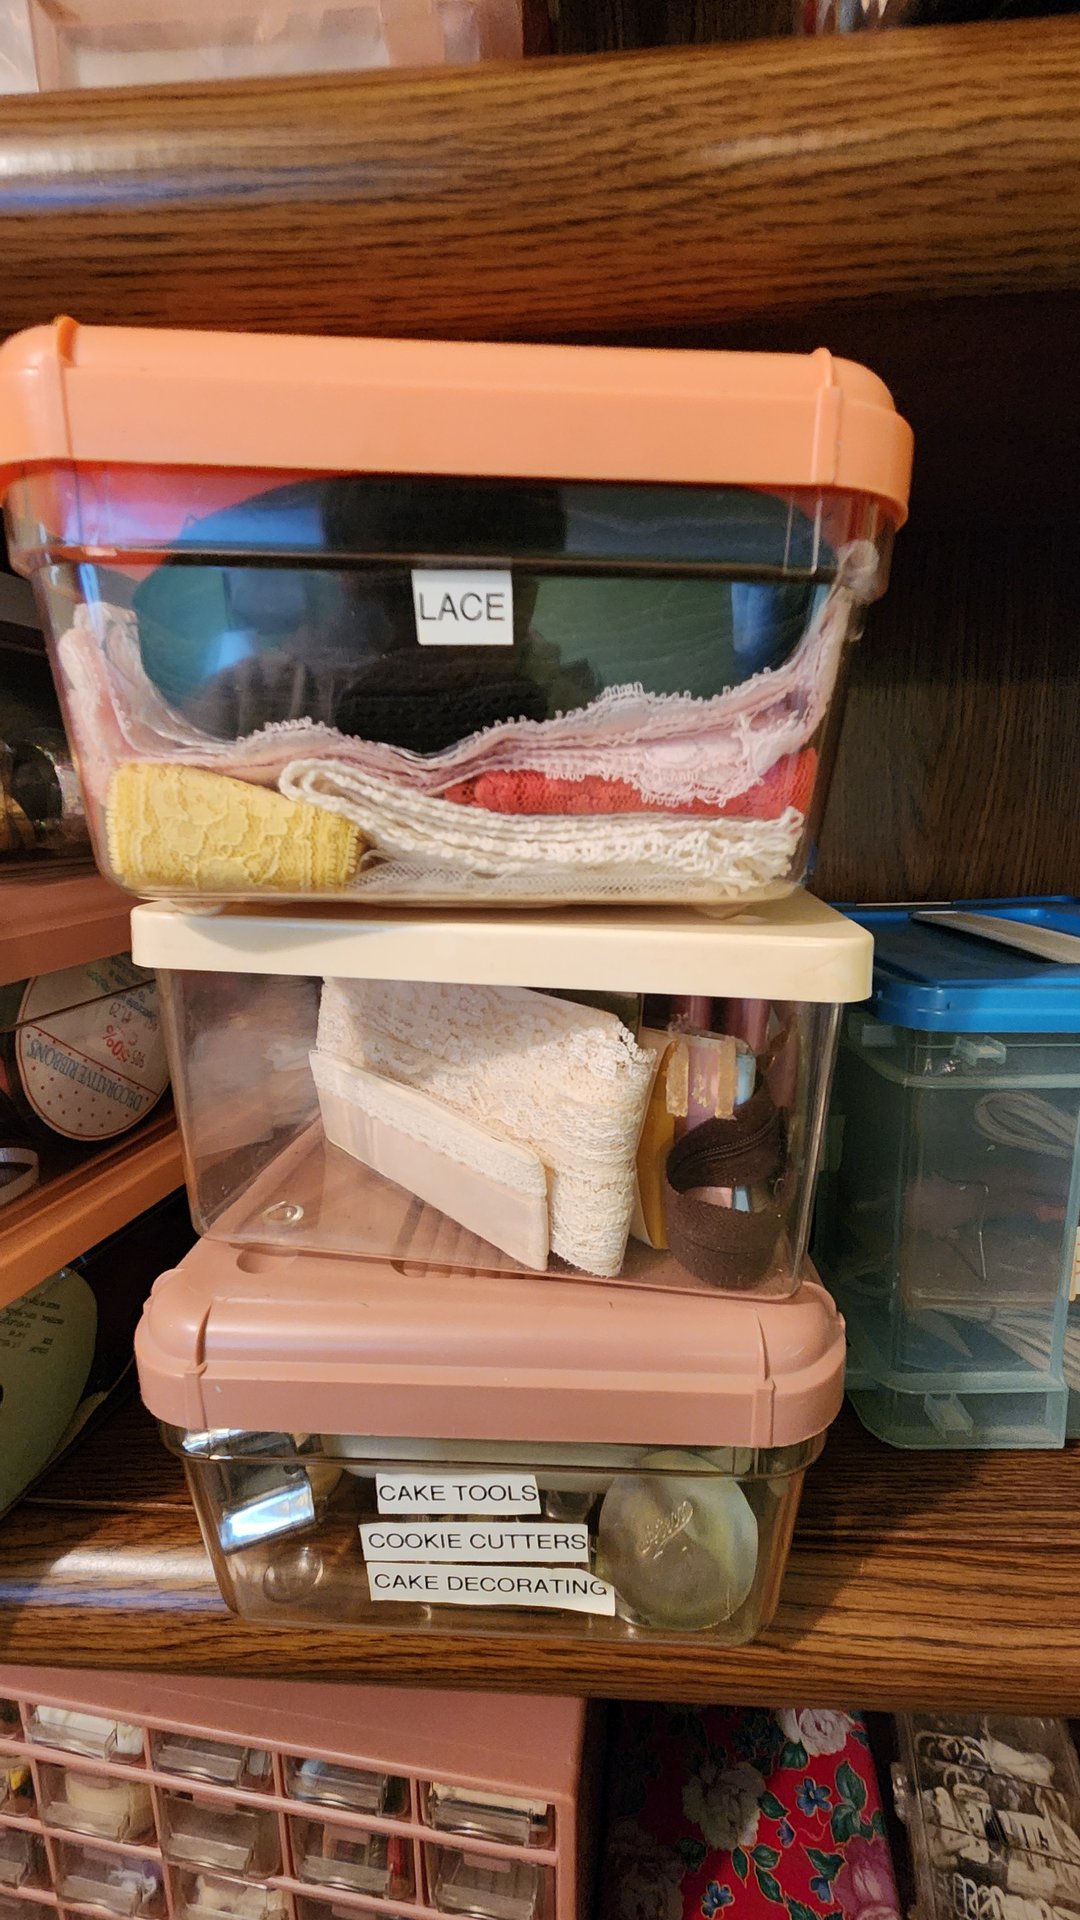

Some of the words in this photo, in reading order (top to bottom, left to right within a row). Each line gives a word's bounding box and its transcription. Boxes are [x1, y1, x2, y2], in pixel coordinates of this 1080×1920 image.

[418, 592, 505, 621] LACE
[26, 1040, 80, 1080] RIBBONS
[79, 1062, 143, 1112] DECORATIVE
[378, 1485, 446, 1501] CAKE
[452, 1485, 538, 1502] TOOLS
[368, 1533, 463, 1550] COOKIE
[469, 1533, 587, 1550] CUTTERS
[374, 1573, 439, 1590] CAKE
[447, 1576, 607, 1595] DECORATING
